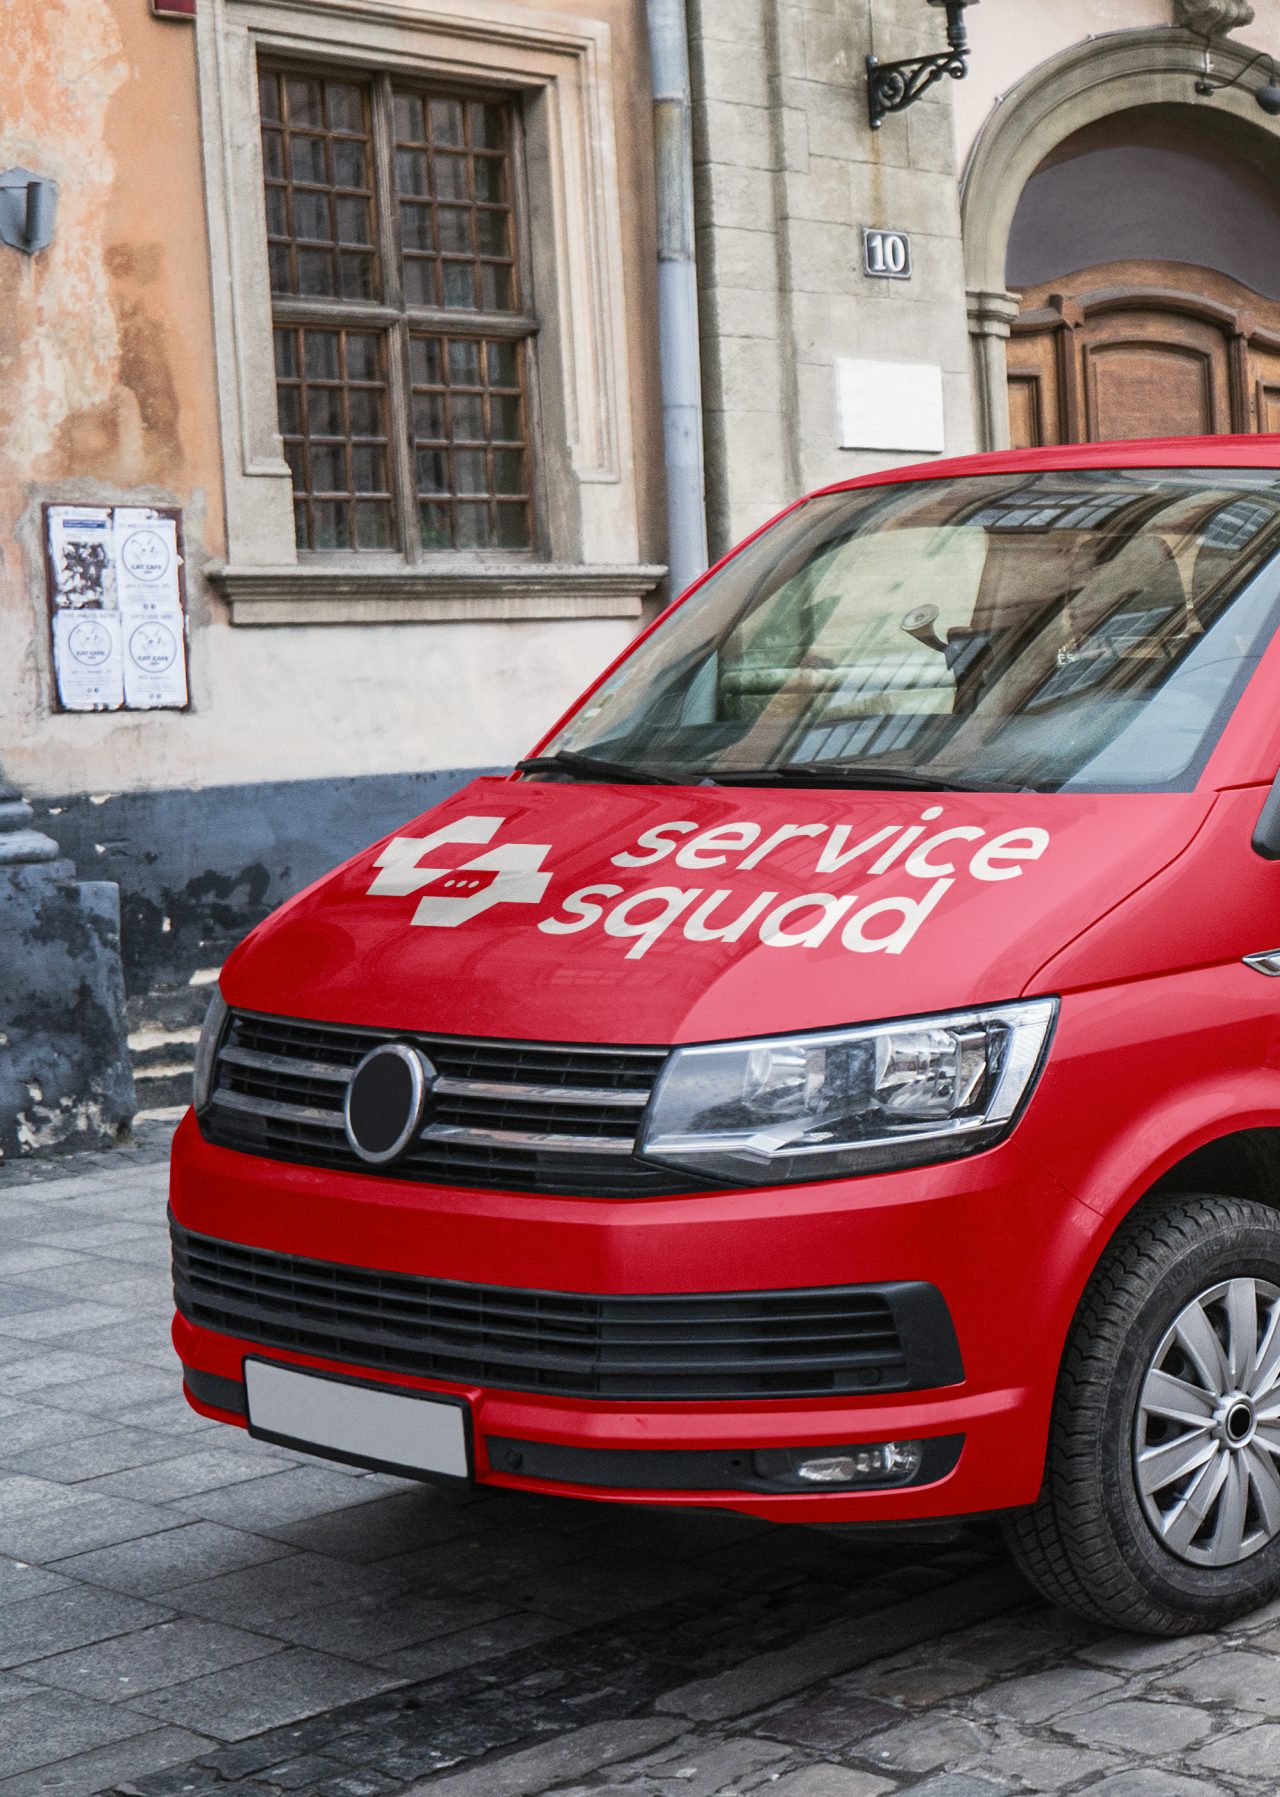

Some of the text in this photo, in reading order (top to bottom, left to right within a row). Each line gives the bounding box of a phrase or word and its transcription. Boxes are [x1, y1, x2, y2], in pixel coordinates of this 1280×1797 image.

[870, 234, 906, 272] 10
[610, 806, 1051, 882] service
[537, 878, 957, 960] squad
